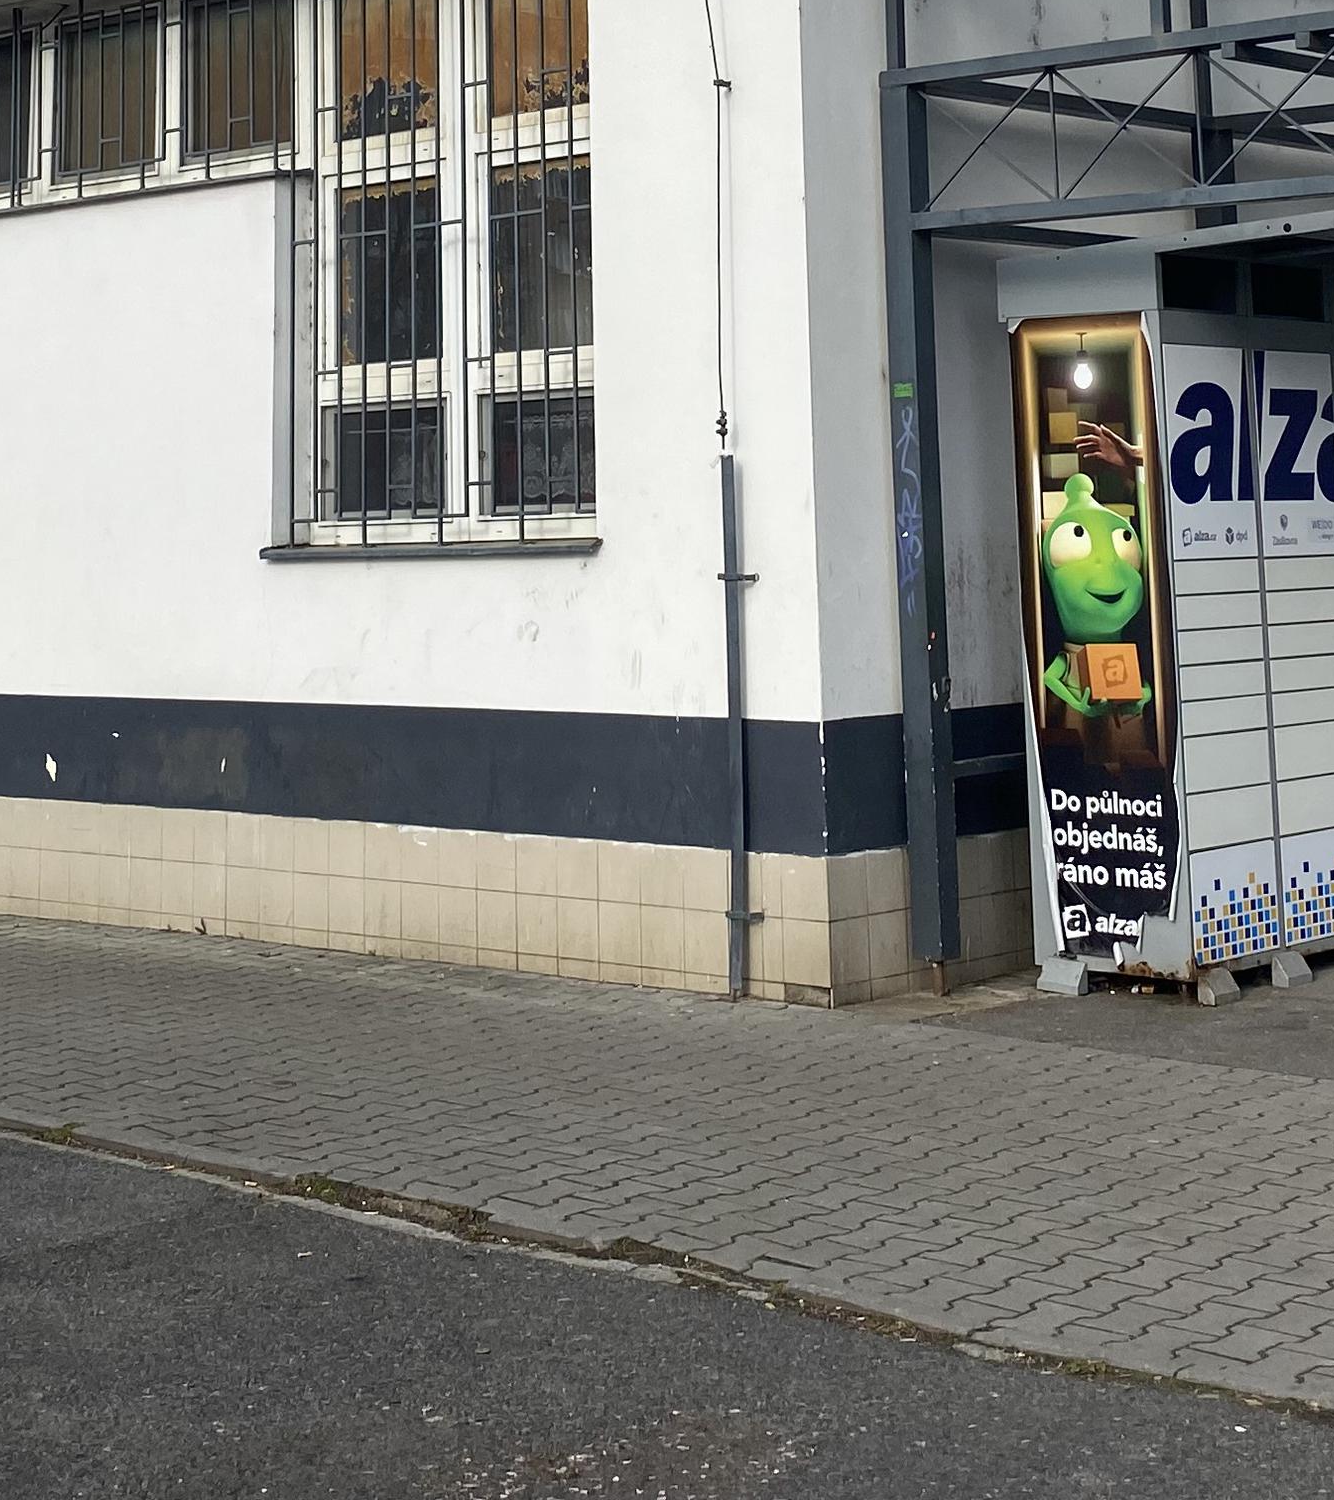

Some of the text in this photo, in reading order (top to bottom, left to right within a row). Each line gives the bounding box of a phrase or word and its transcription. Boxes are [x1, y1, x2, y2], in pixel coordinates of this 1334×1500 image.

[1050, 788, 1163, 820] Do půlnoci
[1053, 821, 1164, 857] objednáš,
[1056, 857, 1167, 890] ráno máš
[1094, 913, 1141, 937] alza
